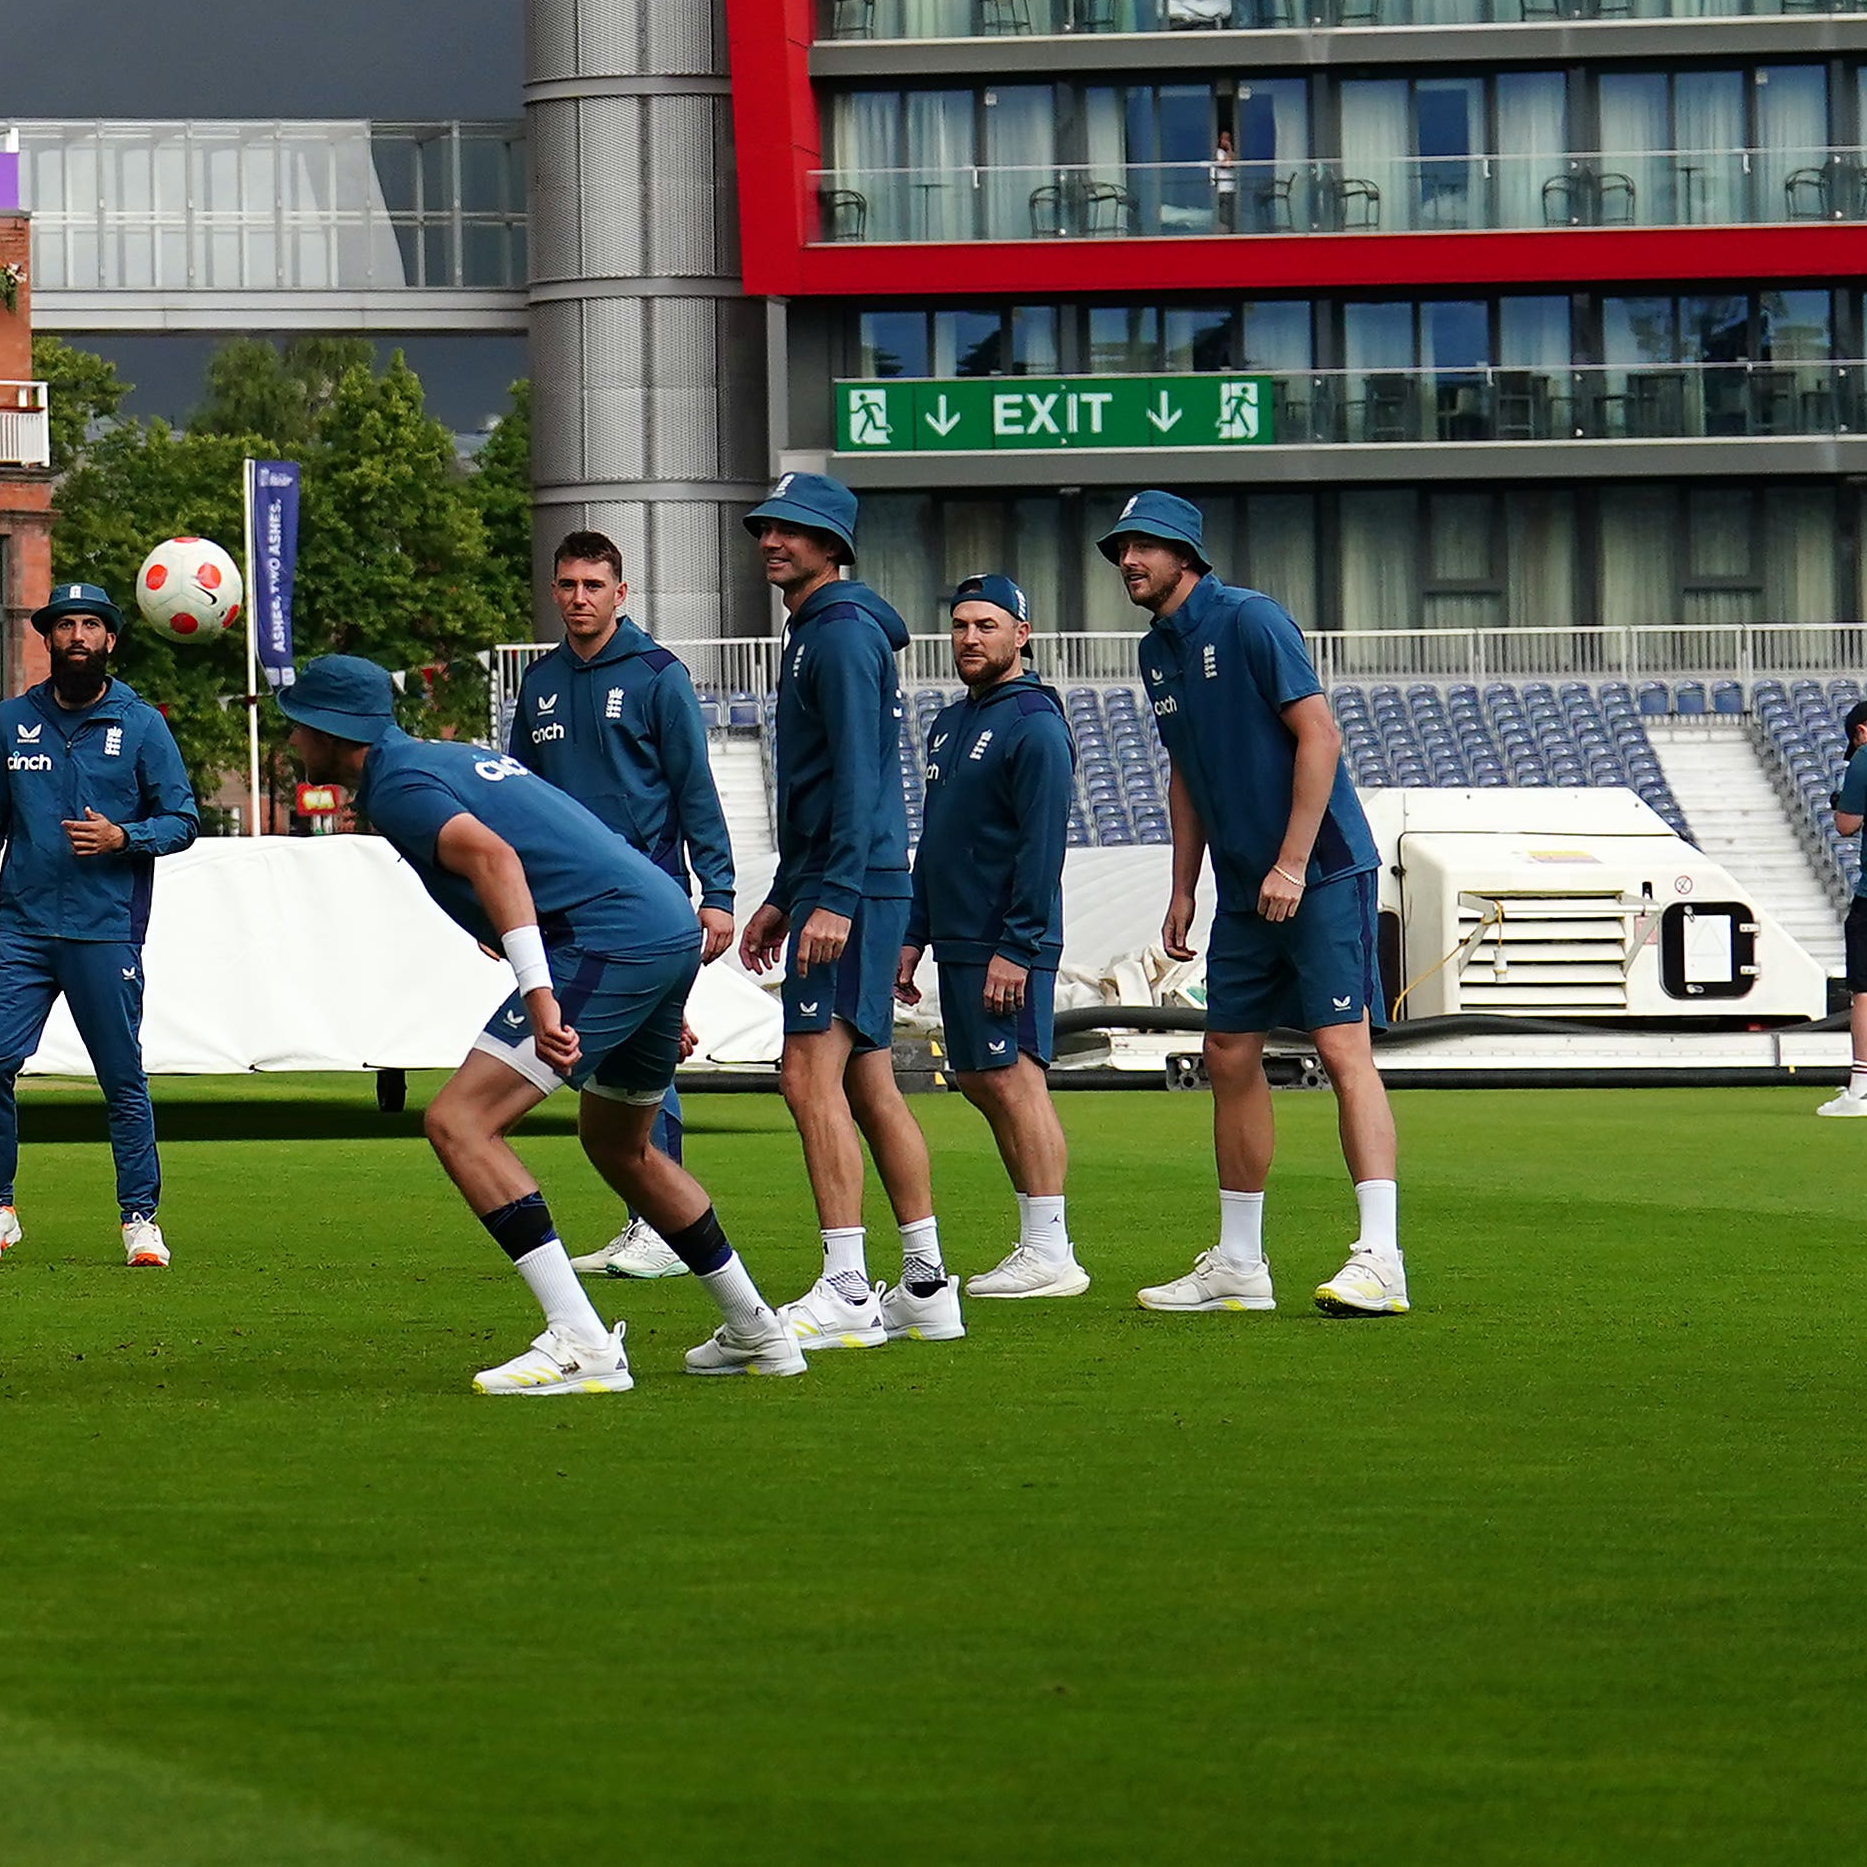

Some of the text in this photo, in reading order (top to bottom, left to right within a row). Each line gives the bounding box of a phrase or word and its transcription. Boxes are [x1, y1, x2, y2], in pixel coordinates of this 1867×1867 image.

[994, 393, 1113, 435] EXIT
[267, 557, 280, 594] TWO
[7, 750, 52, 771] cinch
